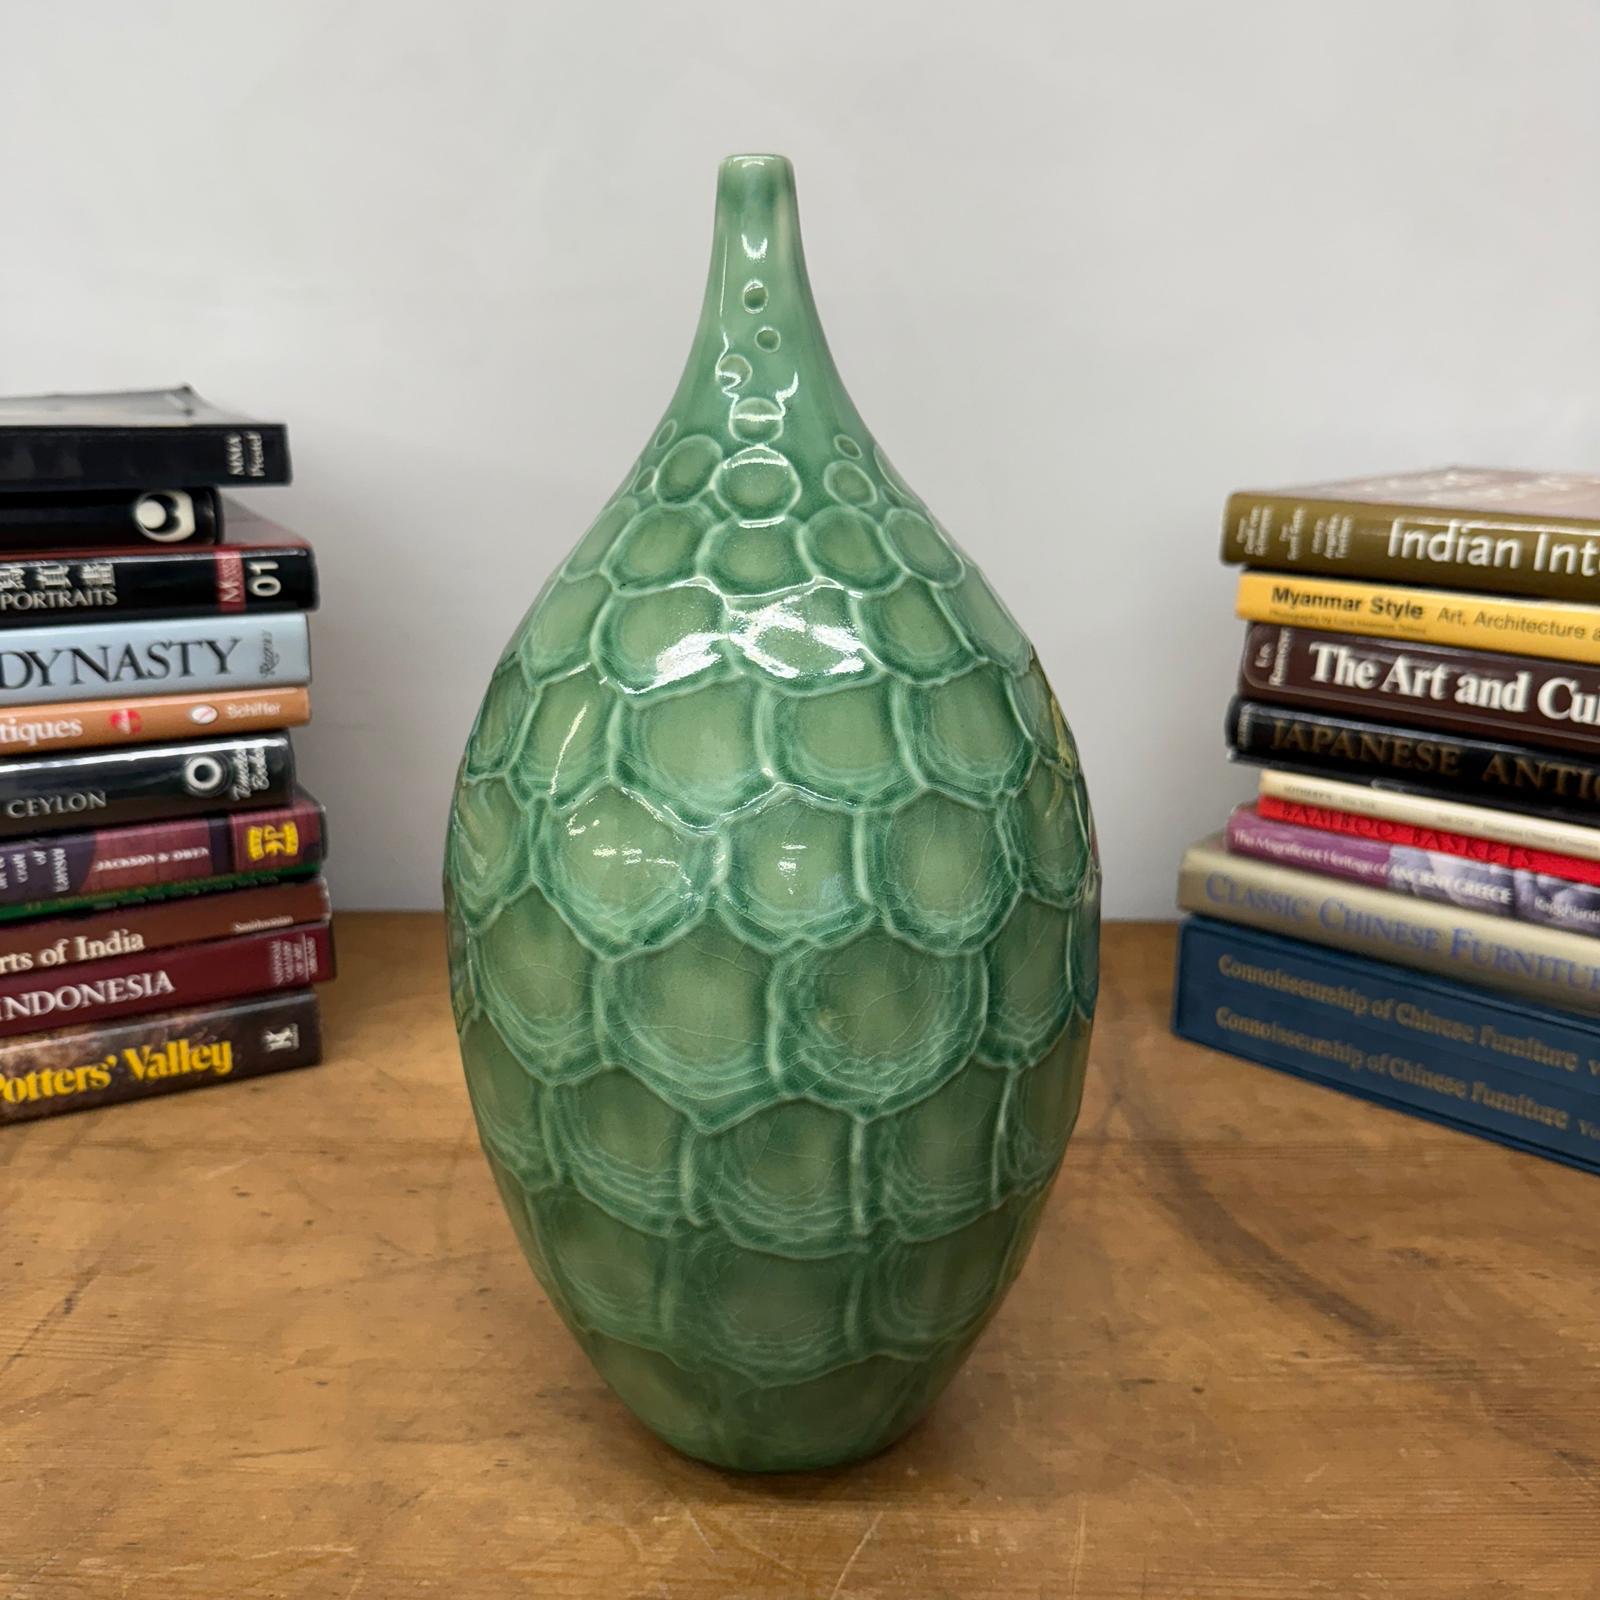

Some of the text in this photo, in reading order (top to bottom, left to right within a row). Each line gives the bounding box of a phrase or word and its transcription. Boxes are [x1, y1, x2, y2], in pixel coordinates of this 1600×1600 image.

[1387, 515, 1600, 577] Indian Int
[0, 587, 118, 611] PORTRAITS
[1271, 587, 1362, 613] Myanmar
[1370, 596, 1424, 620] Style
[1437, 606, 1467, 627] Art,
[1474, 610, 1587, 641] Architecture
[0, 638, 242, 691] DYNASTY
[1308, 641, 1380, 690] The
[1380, 654, 1449, 701] Art
[1454, 671, 1532, 713] and
[226, 701, 282, 719] Schiffer
[1271, 719, 1462, 777] JAPANESE
[7, 790, 108, 819] CEYLON
[95, 854, 155, 872] JACKSON
[158, 852, 169, 863] &
[1234, 830, 1254, 845] The
[1256, 836, 1322, 864] Magnificent
[1390, 864, 1452, 892] ANCIENT
[1455, 878, 1514, 905] GREECE
[1205, 870, 1312, 922] CLASSIC
[1318, 895, 1440, 953] CHINESE
[40, 938, 70, 966] of
[74, 927, 146, 961] India
[0, 969, 176, 1023] NDONESIA
[1218, 953, 1368, 1016] Connoisseurship
[1371, 998, 1396, 1021] of
[1395, 1002, 1475, 1044] Chinese
[1479, 1024, 1578, 1073] Furniture
[0, 1039, 233, 1104] otters' Valley
[1215, 1005, 1363, 1070] Connoisseurship
[1366, 1052, 1391, 1075] of
[1389, 1056, 1467, 1099] Chinese
[1470, 1080, 1569, 1131] Furniture
